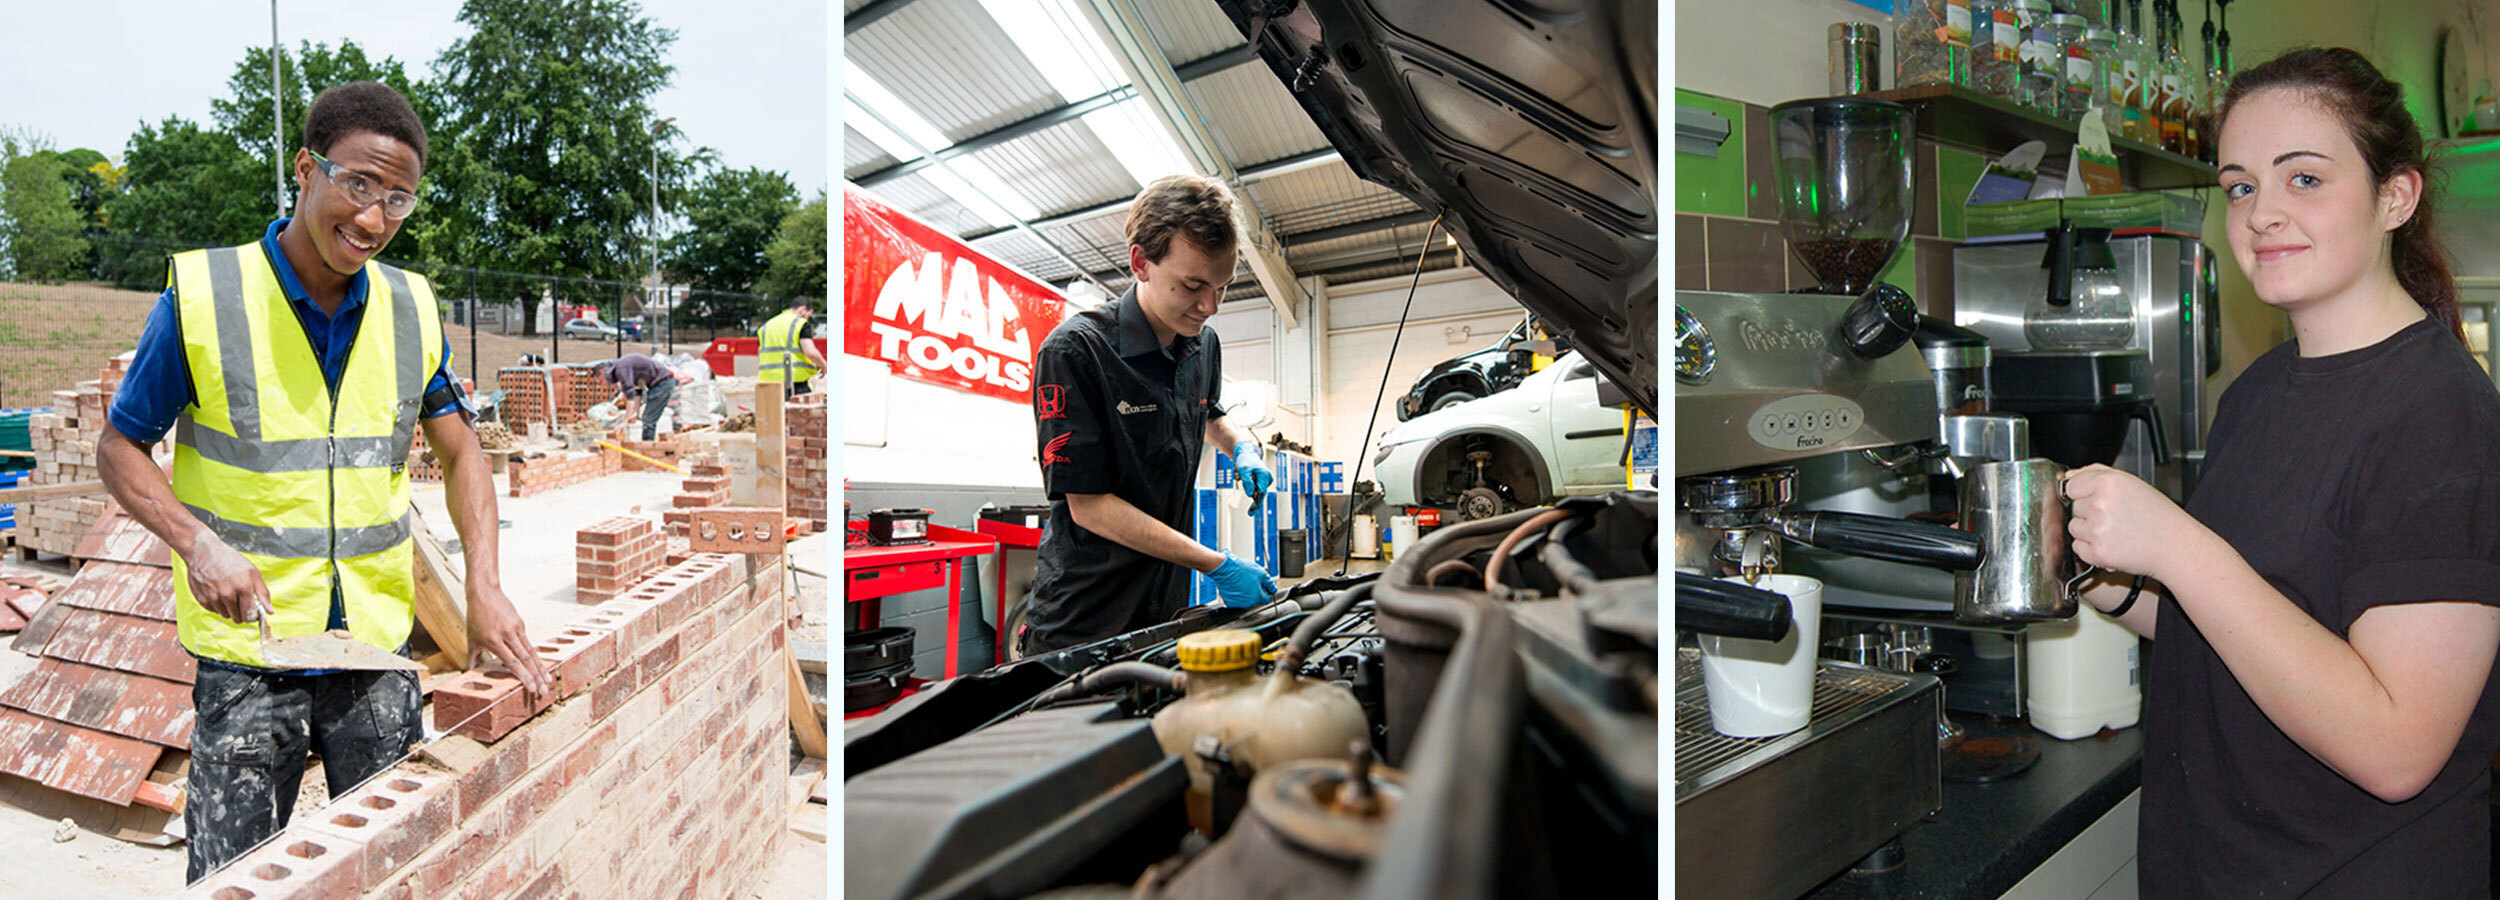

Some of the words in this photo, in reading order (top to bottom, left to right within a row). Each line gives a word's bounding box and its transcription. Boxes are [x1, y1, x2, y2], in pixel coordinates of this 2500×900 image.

[873, 251, 1032, 365] MAC
[871, 321, 1031, 392] TOOLS
[933, 561, 941, 574] 3
